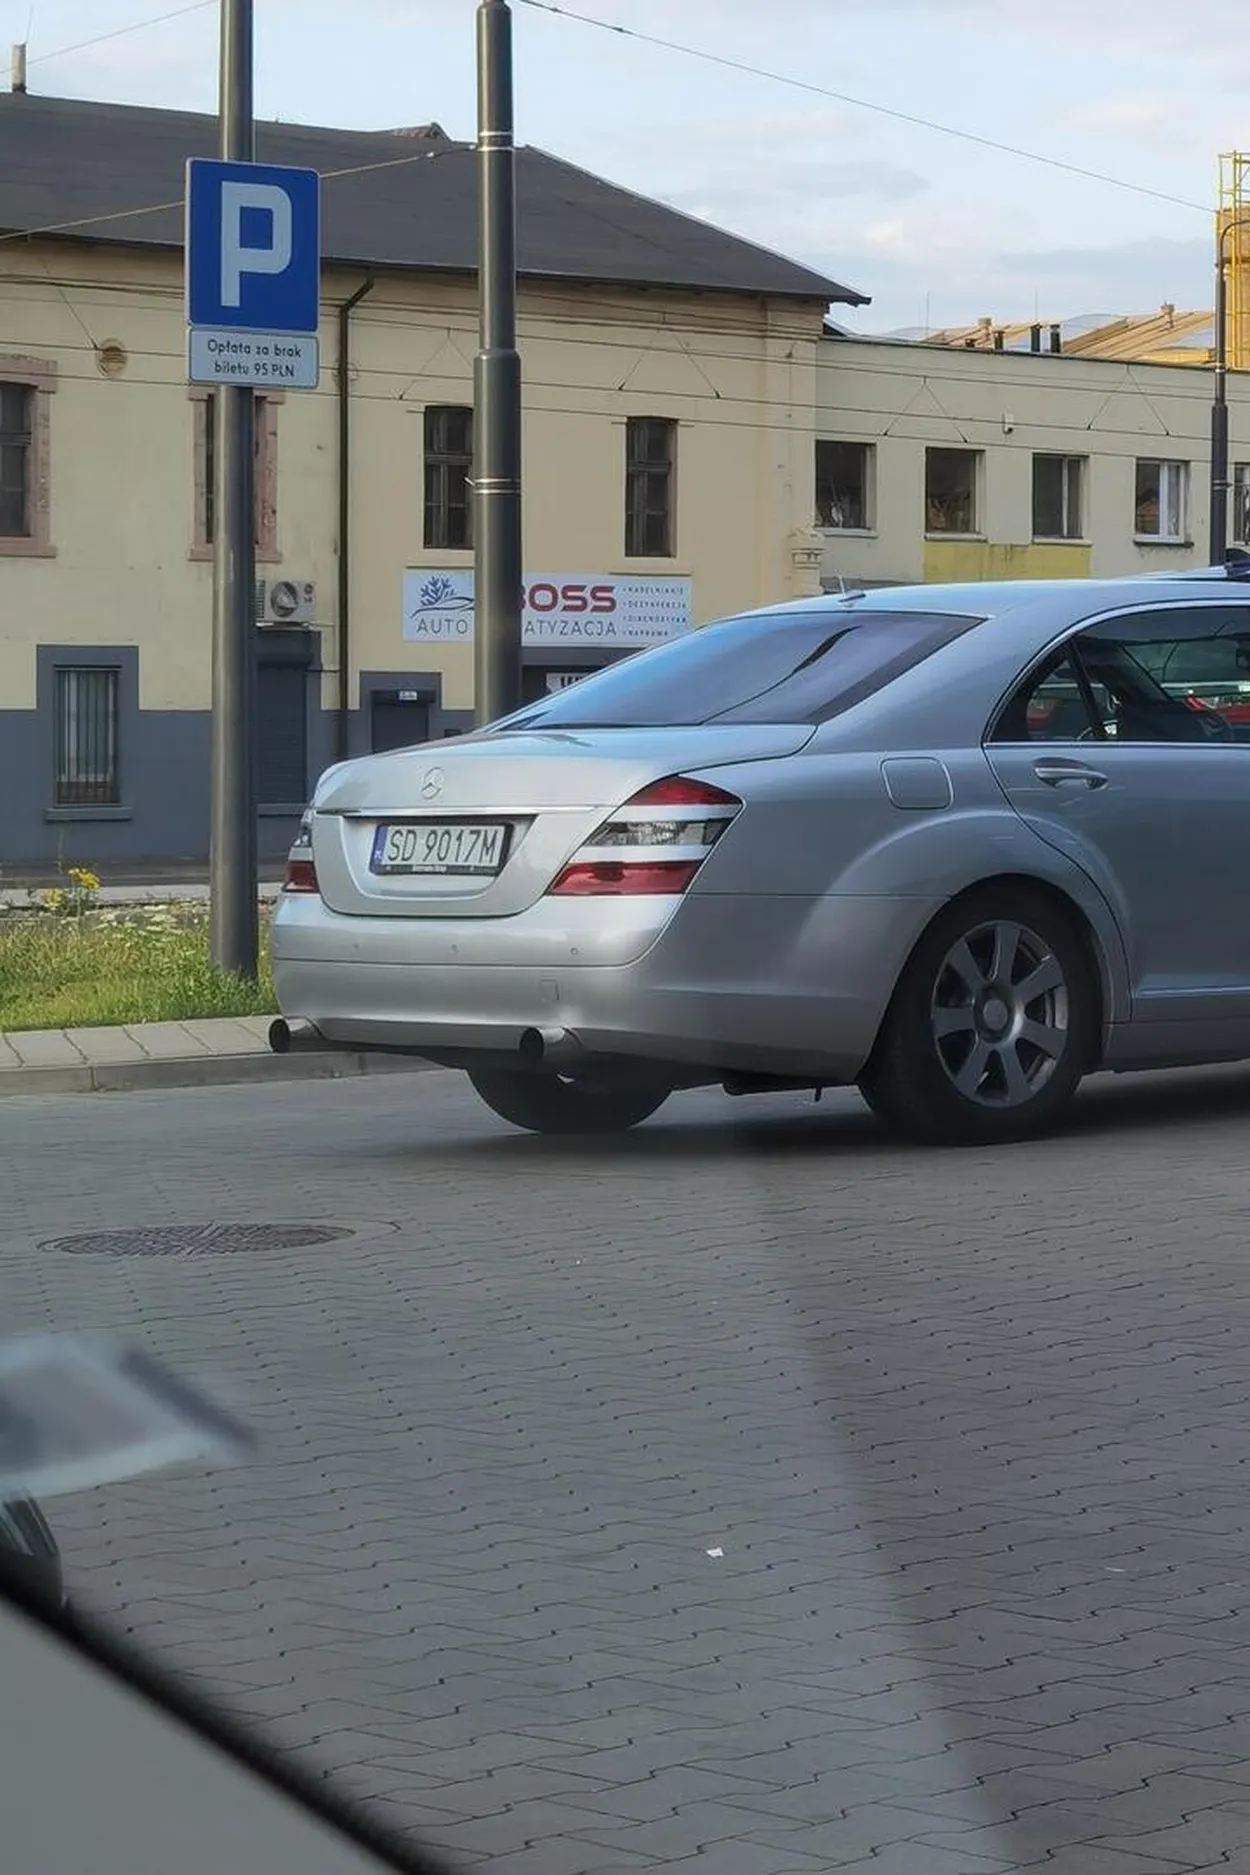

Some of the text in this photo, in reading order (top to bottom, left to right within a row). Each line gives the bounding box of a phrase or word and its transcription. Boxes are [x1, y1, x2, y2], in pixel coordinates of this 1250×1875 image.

[220, 181, 293, 307] P
[207, 339, 302, 358] Opłata za brak
[214, 361, 295, 378] biletu 95 PLN
[520, 583, 617, 613] OSS
[416, 619, 618, 637] AUTO ATYZACJA
[387, 828, 498, 865] SD 9017M
